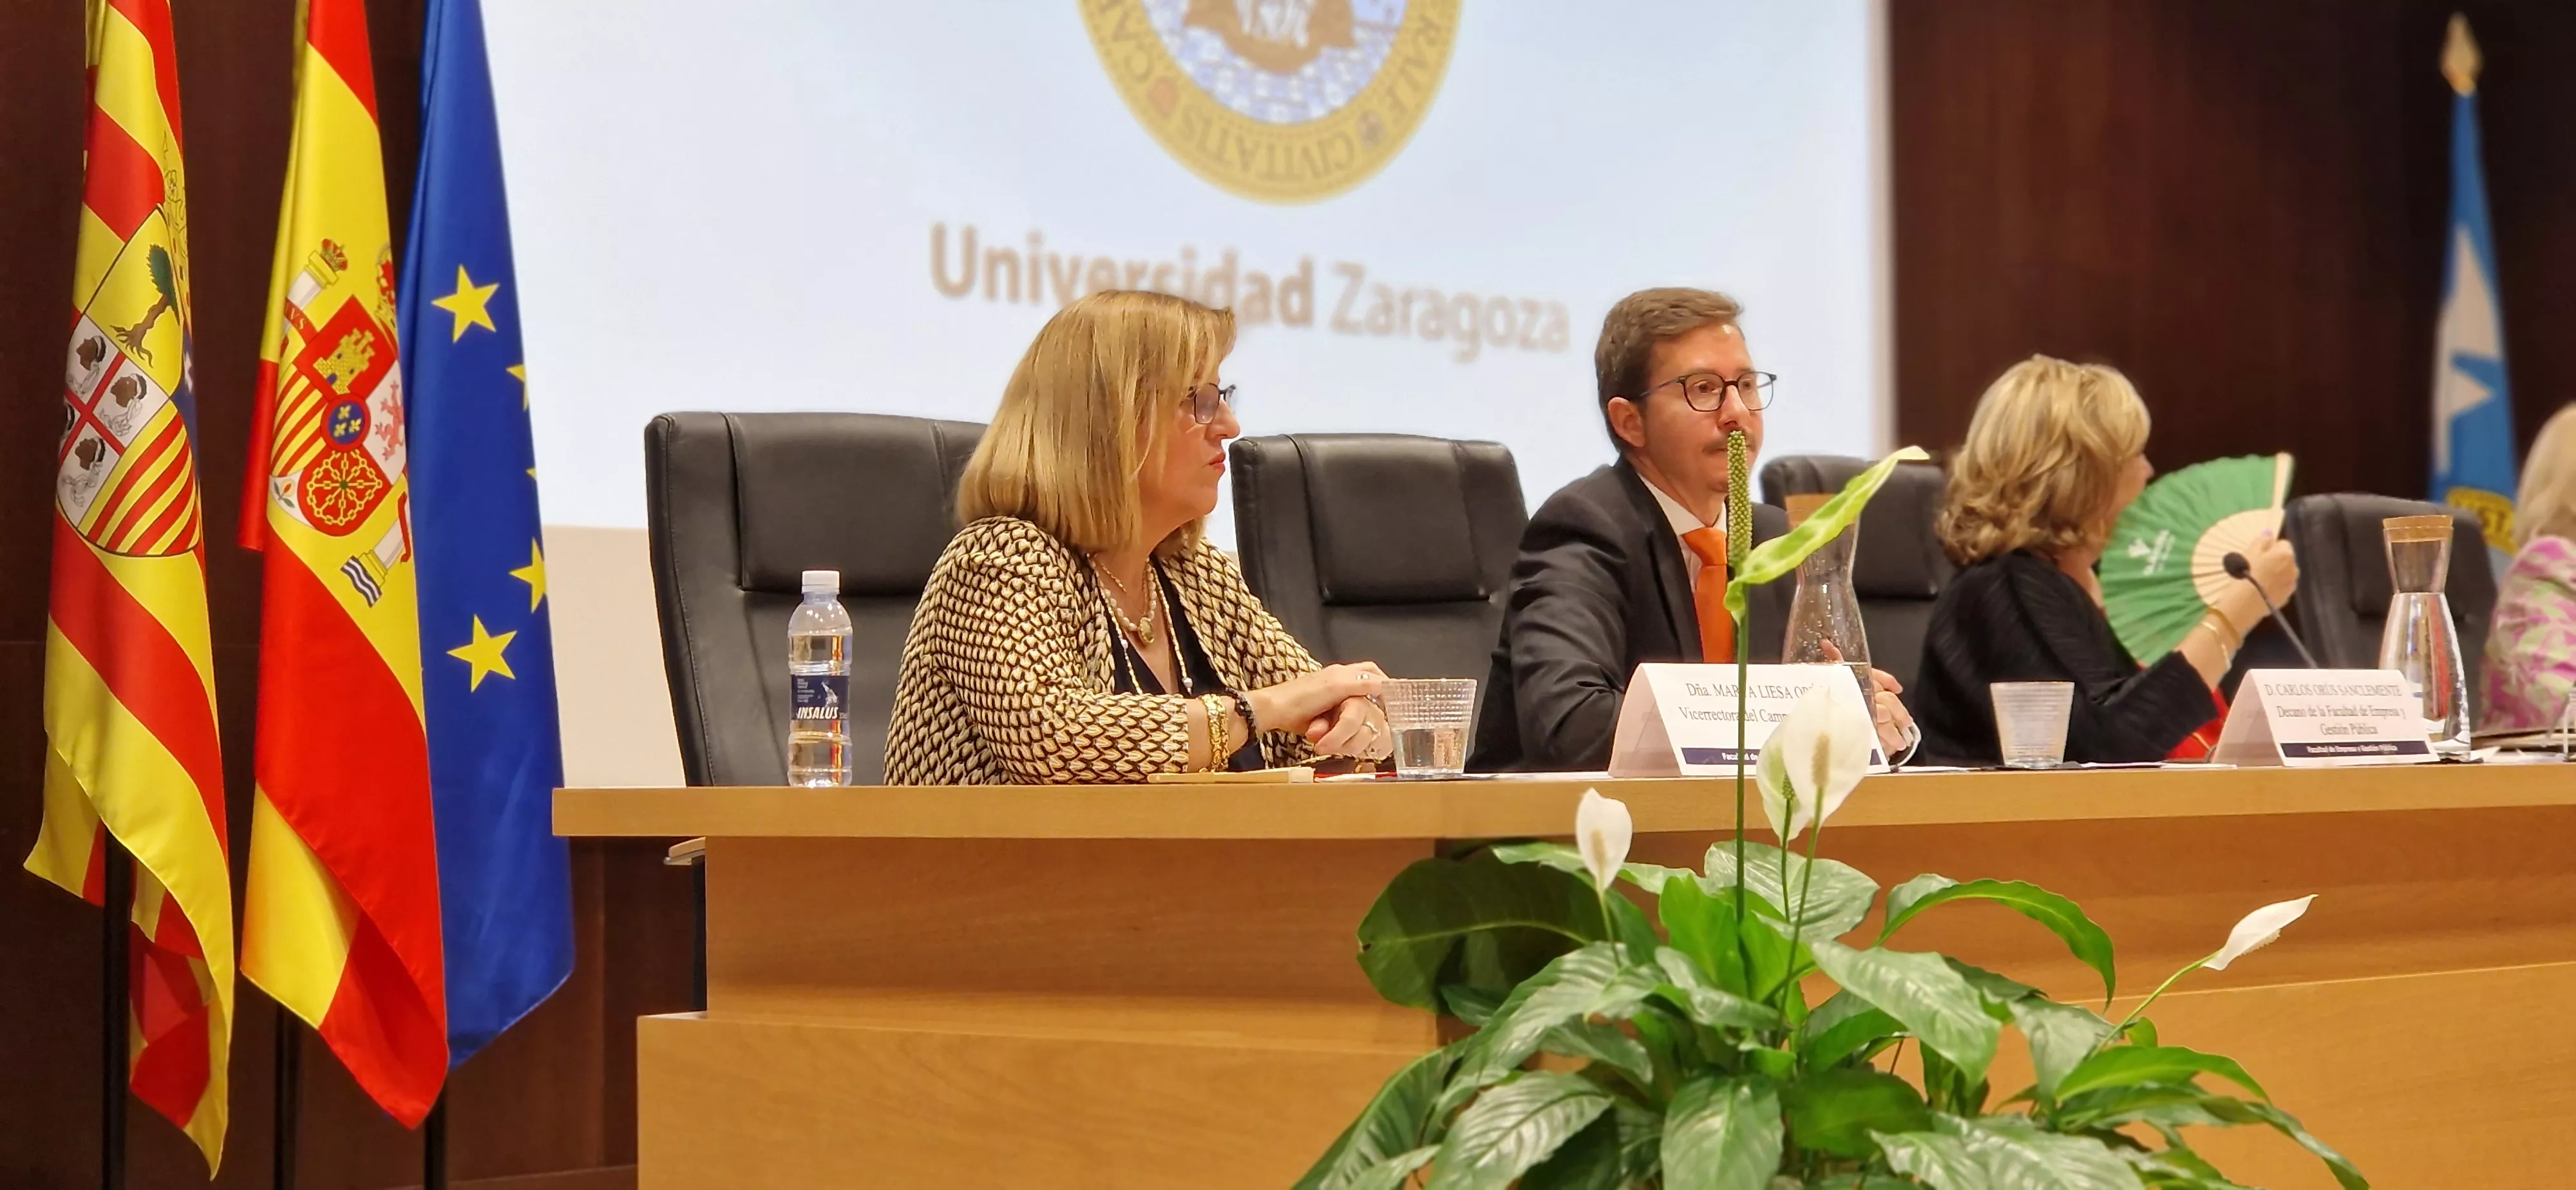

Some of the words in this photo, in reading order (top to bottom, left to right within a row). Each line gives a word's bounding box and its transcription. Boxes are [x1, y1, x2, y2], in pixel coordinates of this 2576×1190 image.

[930, 223, 1314, 327] Universidad
[1331, 261, 1570, 363] Zaragoza
[1712, 683, 1757, 698] MARA
[1757, 685, 1794, 699] LIESA
[2276, 685, 2313, 695] CARLOS
[797, 706, 838, 719] INSALUS
[1678, 707, 1739, 721] Vicerrectora
[1759, 709, 1791, 722] Camp
[2307, 706, 2317, 717] de
[2325, 705, 2358, 717] Facultad
[2359, 706, 2369, 717] de
